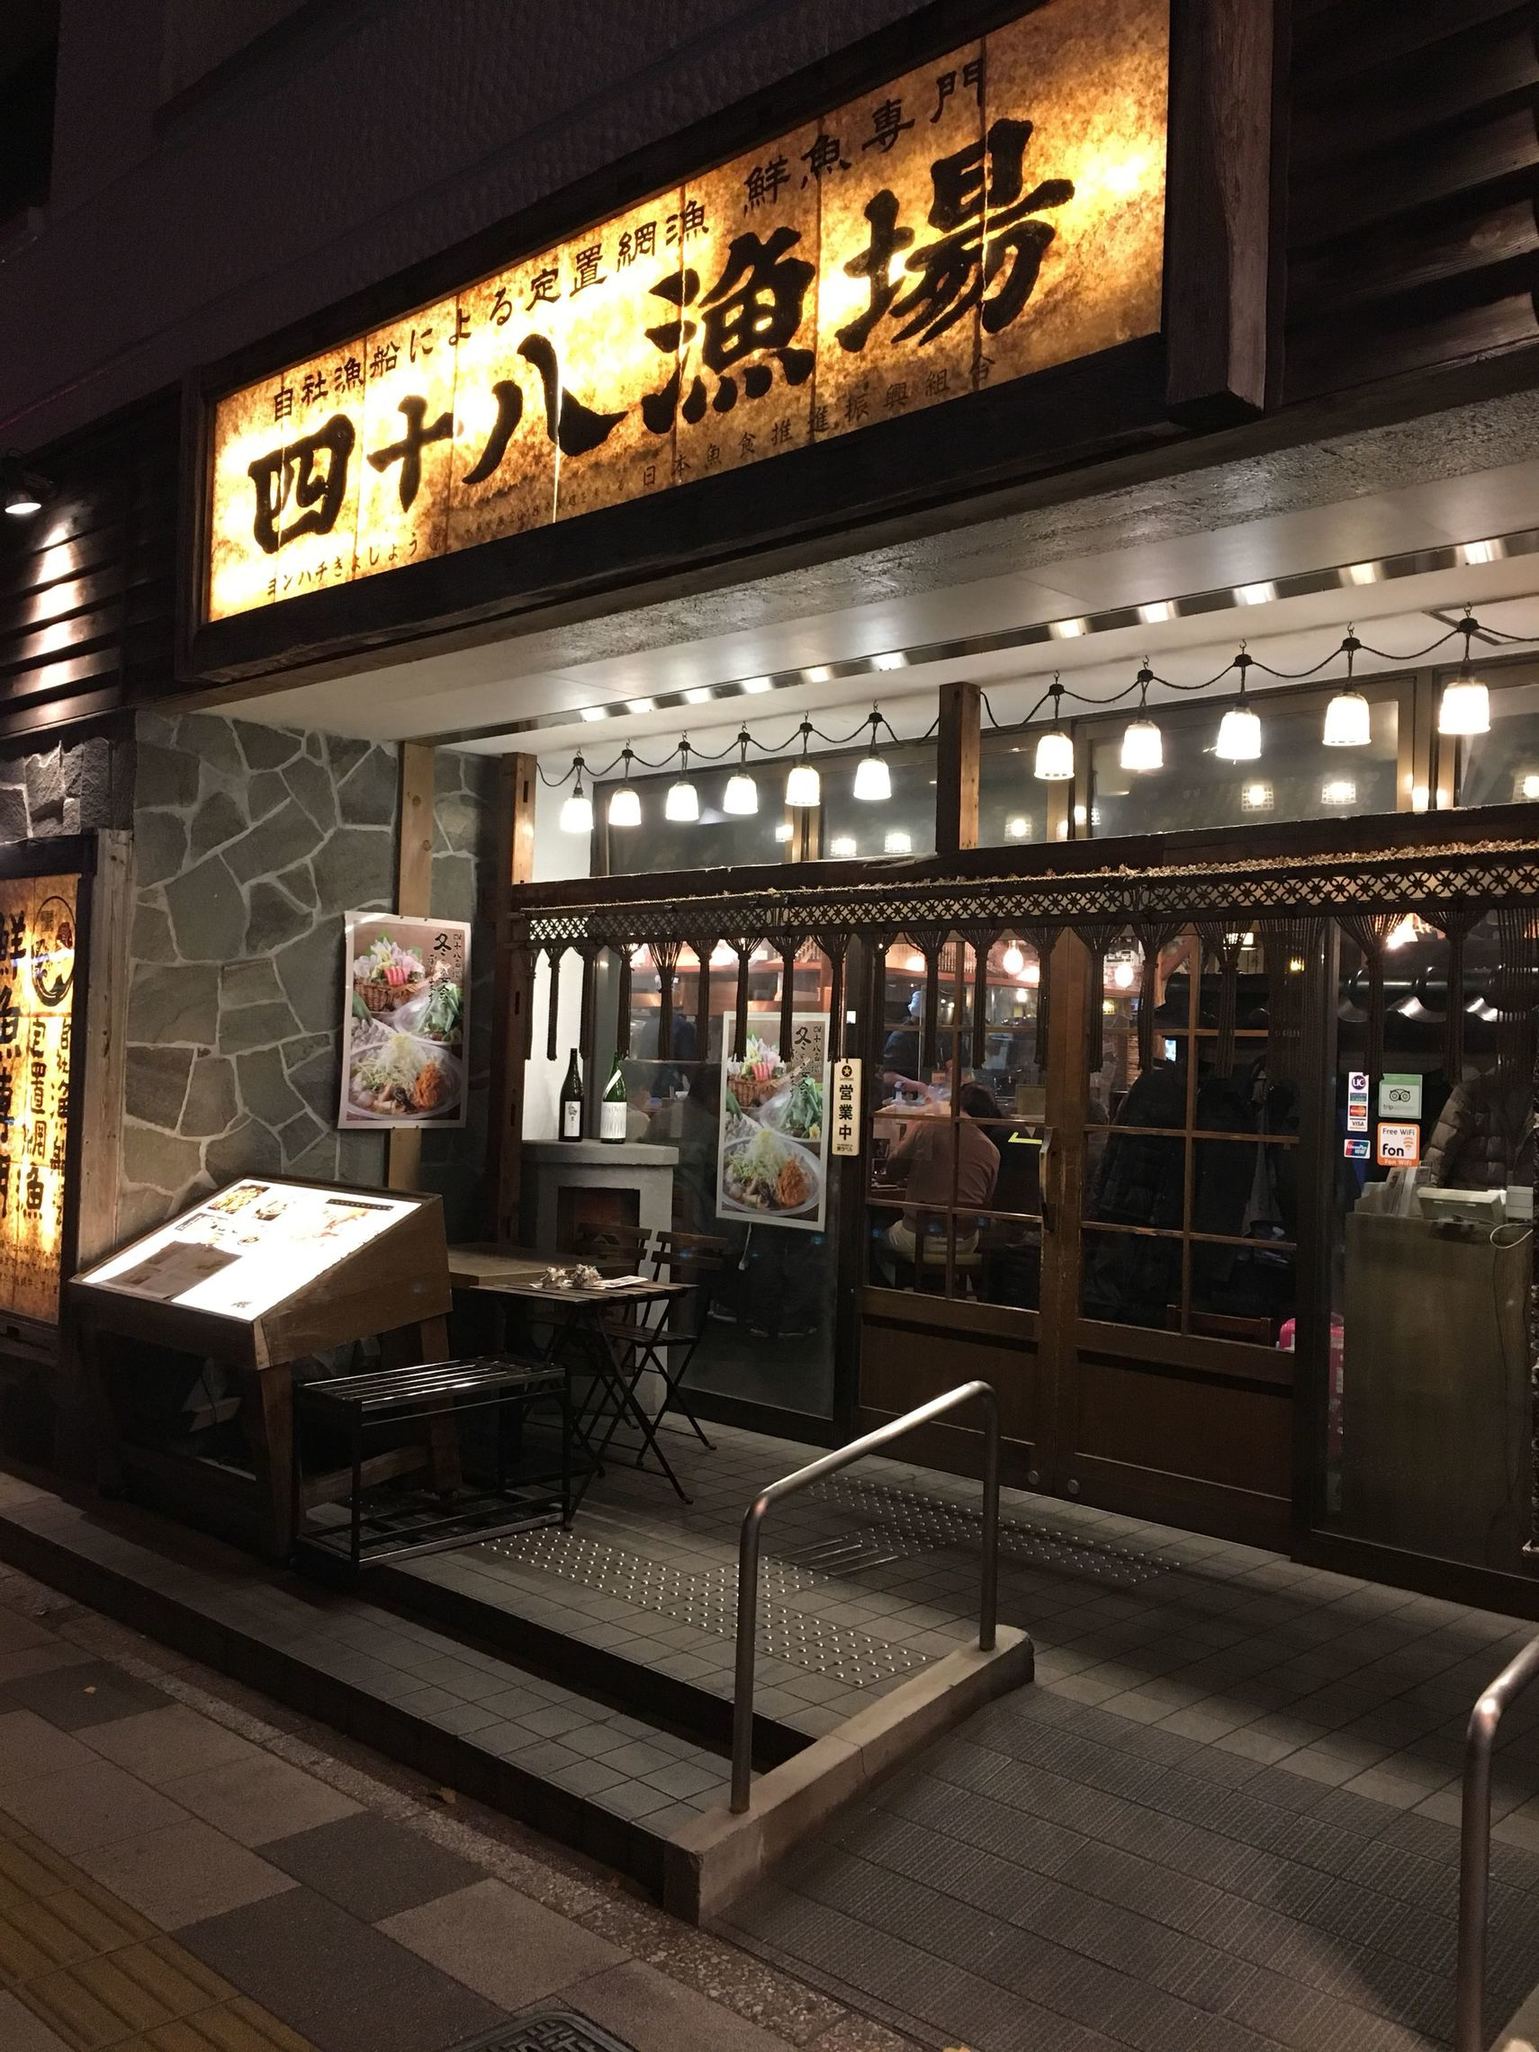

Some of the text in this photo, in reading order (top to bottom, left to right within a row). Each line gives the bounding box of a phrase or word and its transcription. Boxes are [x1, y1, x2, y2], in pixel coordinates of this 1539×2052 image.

[273, 57, 985, 422] 自社漁船による定置網漁 鮮魚専門
[248, 118, 1076, 555] 四十八漁場
[838, 1084, 854, 1141] 営業中
[1382, 1128, 1415, 1136] Free WiFi
[1382, 1143, 1405, 1157] fon
